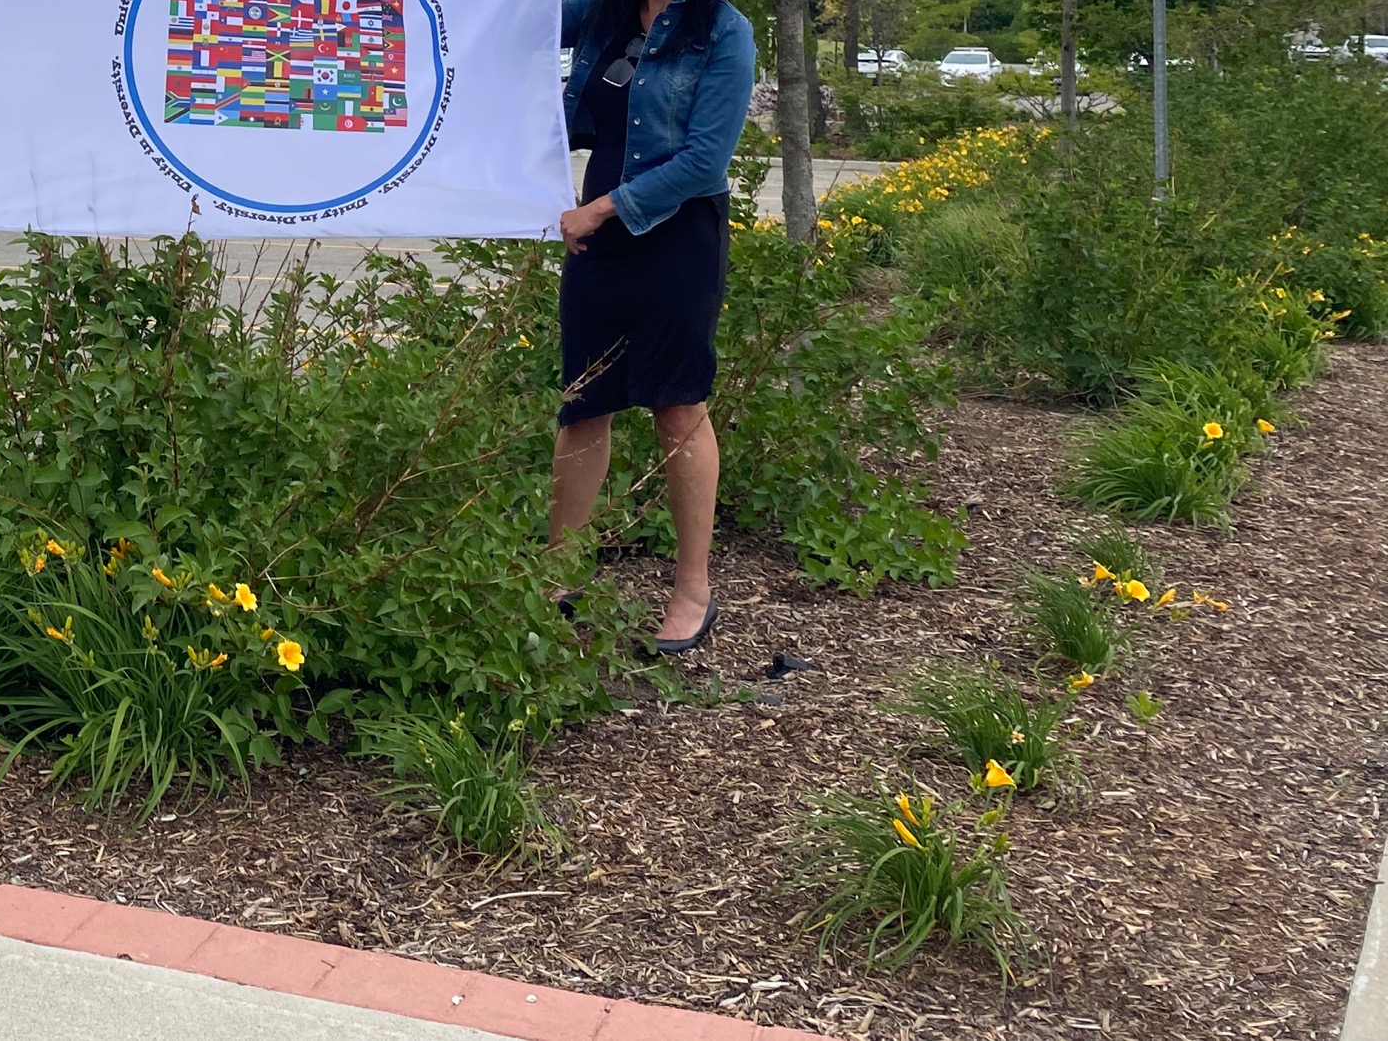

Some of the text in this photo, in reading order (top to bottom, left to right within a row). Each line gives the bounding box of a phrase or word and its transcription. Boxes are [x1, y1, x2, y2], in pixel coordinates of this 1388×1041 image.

[111, 56, 193, 193] Unity in Diversity.
[378, 67, 455, 194] Unity in Diversity.
[212, 197, 369, 225] Unity in Diversity.
